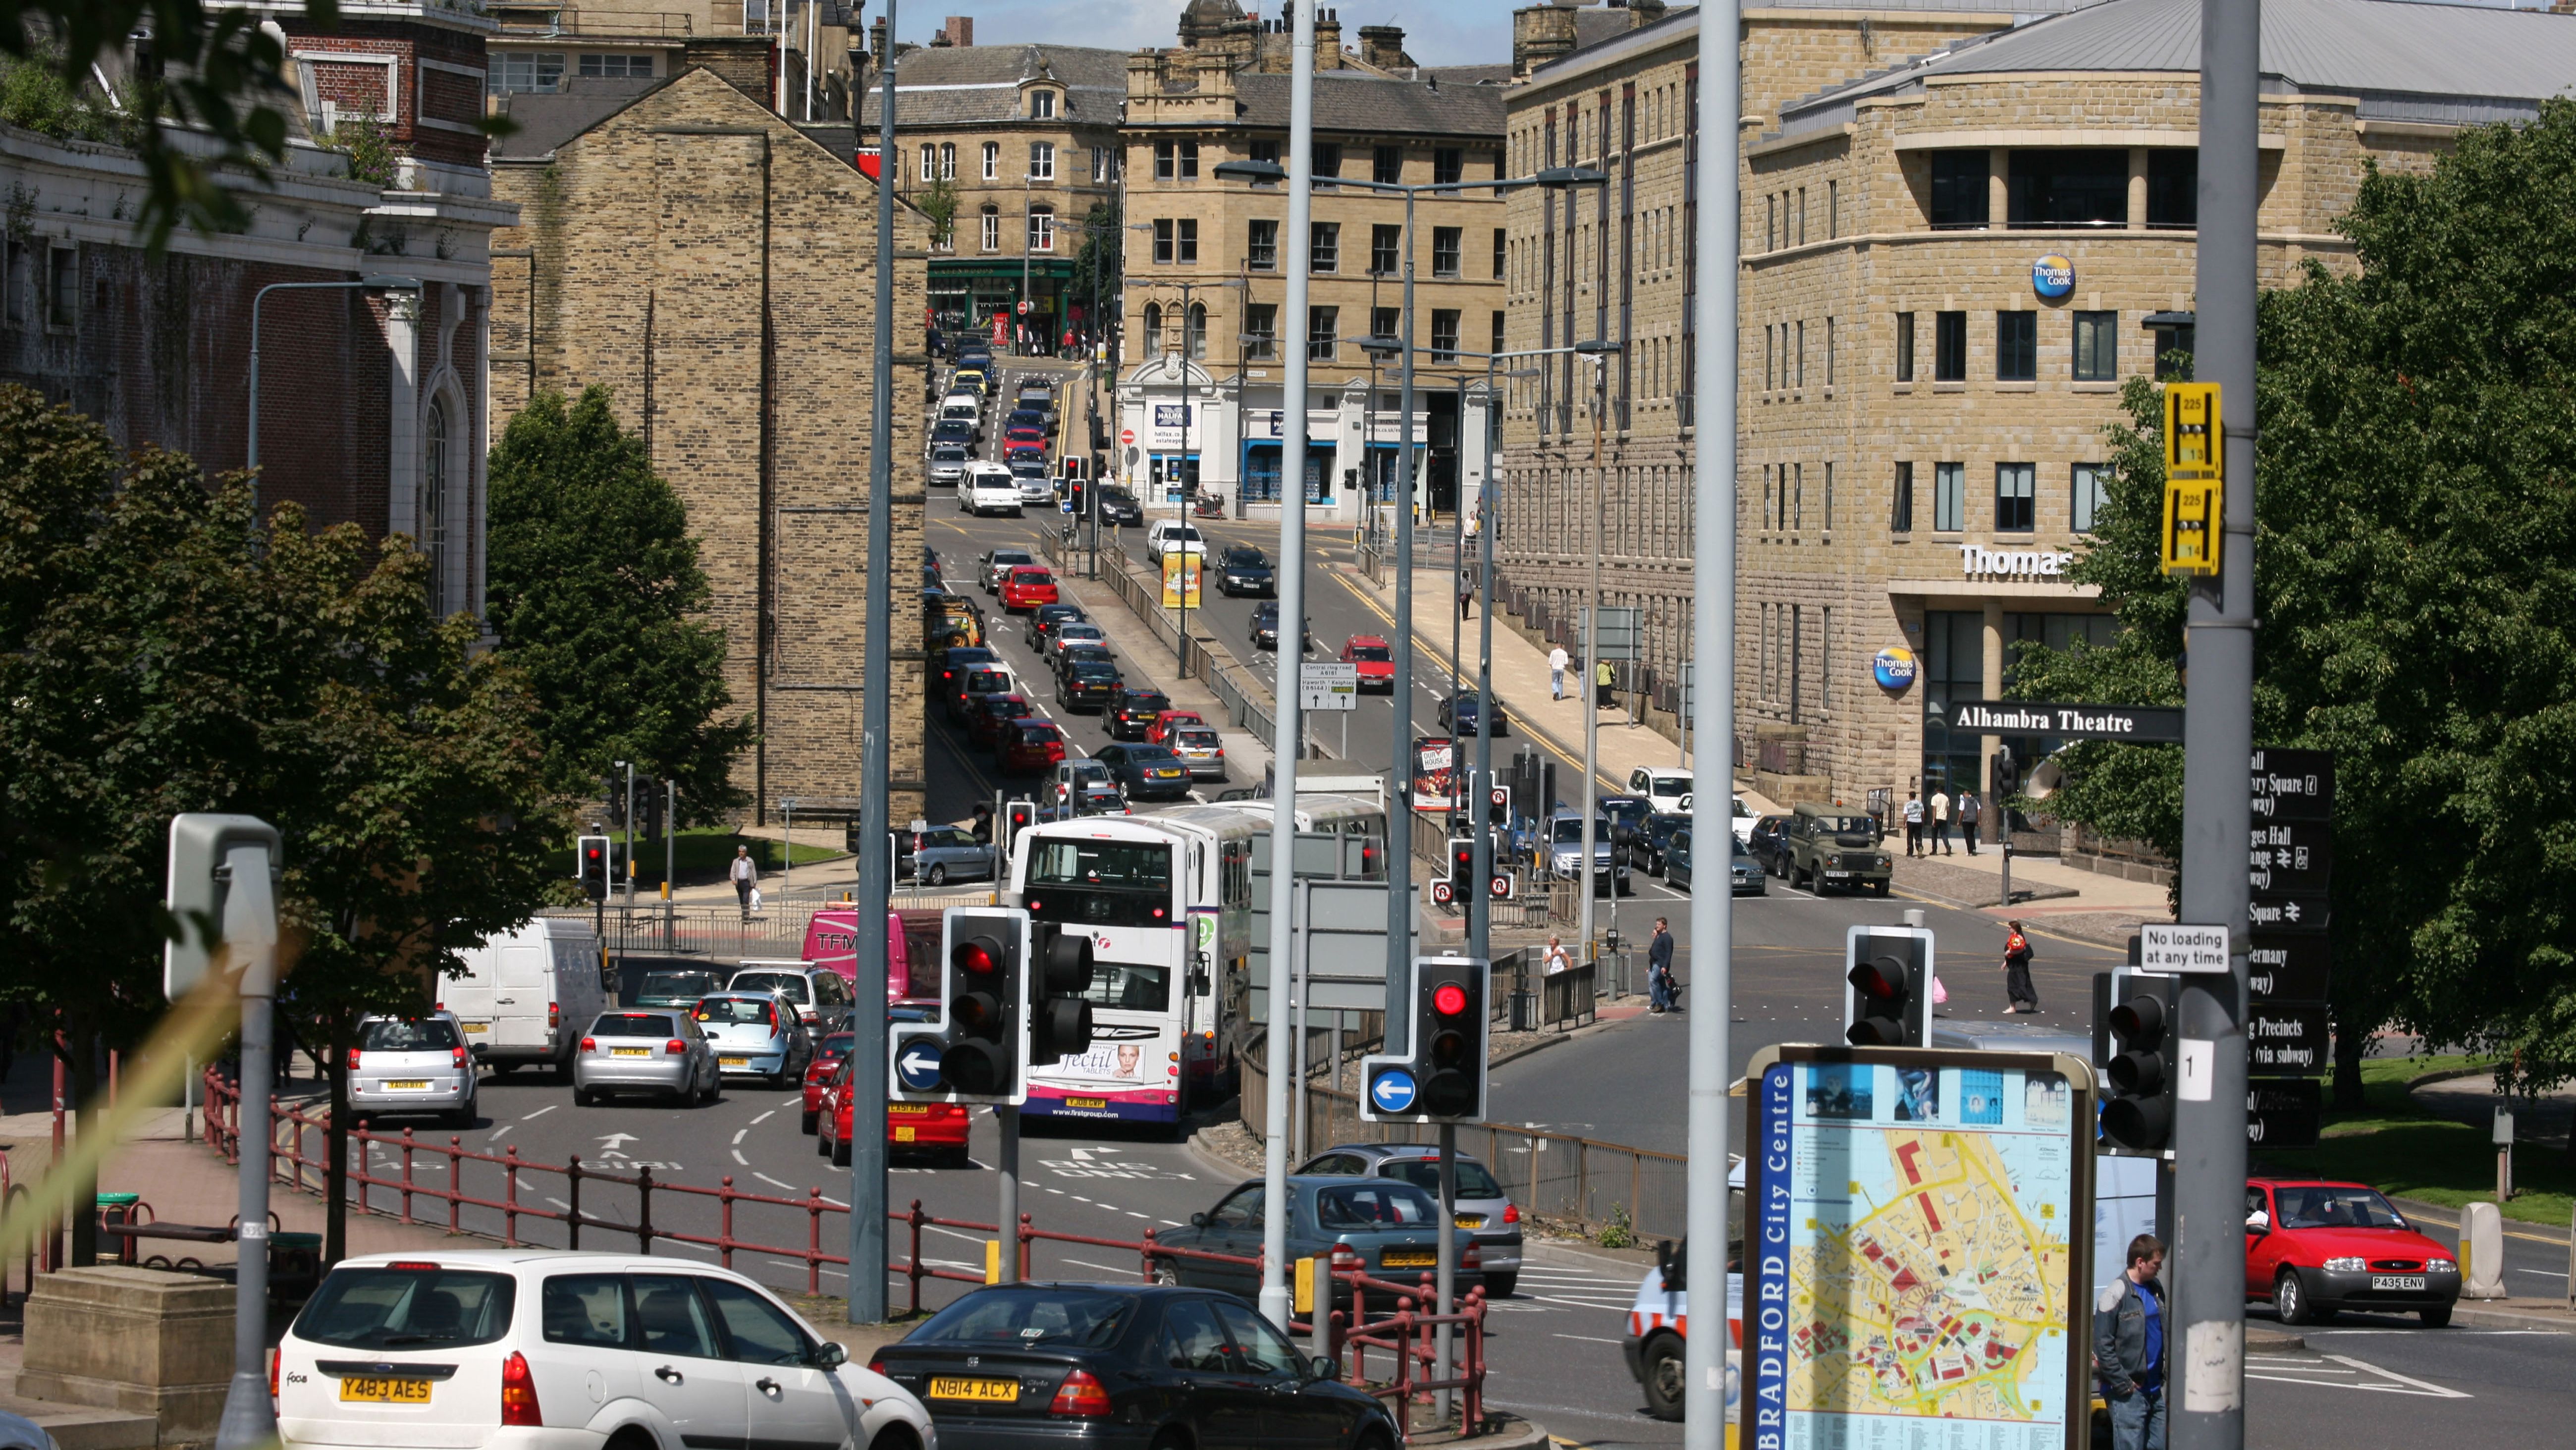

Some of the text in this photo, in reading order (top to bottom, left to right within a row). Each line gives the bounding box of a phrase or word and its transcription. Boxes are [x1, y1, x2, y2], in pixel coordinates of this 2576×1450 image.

[2034, 267, 2071, 276] Thomas
[2047, 276, 2071, 285] Cook
[2184, 399, 2201, 410] 225
[2183, 495, 2201, 506] 225
[1959, 544, 2073, 575] Thomas
[1876, 658, 1913, 668] Thomas
[1889, 667, 1912, 677] Cook
[1957, 707, 2133, 732] Alhambra Theatre
[1425, 757, 1443, 766] HOUSE
[2251, 752, 2264, 770] all
[2251, 777, 2267, 795] ary
[2269, 773, 2302, 797] Square
[2251, 794, 2274, 816] way)
[2251, 826, 2291, 848] ges Hall
[2250, 851, 2271, 868] ange
[2250, 867, 2270, 889] way)
[2250, 903, 2281, 925] Square
[816, 933, 857, 951] TFM
[2148, 931, 2222, 949] No loading
[2147, 951, 2223, 966] at any time
[2249, 971, 2272, 995] way)
[2258, 1017, 2303, 1037] Precincts
[1061, 1048, 1116, 1074] fectil
[2255, 1045, 2313, 1068] (via subway)
[2186, 1055, 2192, 1078] 1
[1052, 1109, 1119, 1118] www.firstgroup.com
[1037, 1160, 1158, 1170] BUS
[1051, 1169, 1196, 1180] ONLY
[1758, 1075, 1790, 1450] BRADFORD City Centre
[2374, 1278, 2423, 1288] P435 ENV
[344, 1379, 428, 1398] Y483 AES
[936, 1380, 1013, 1397] N814 ACX
